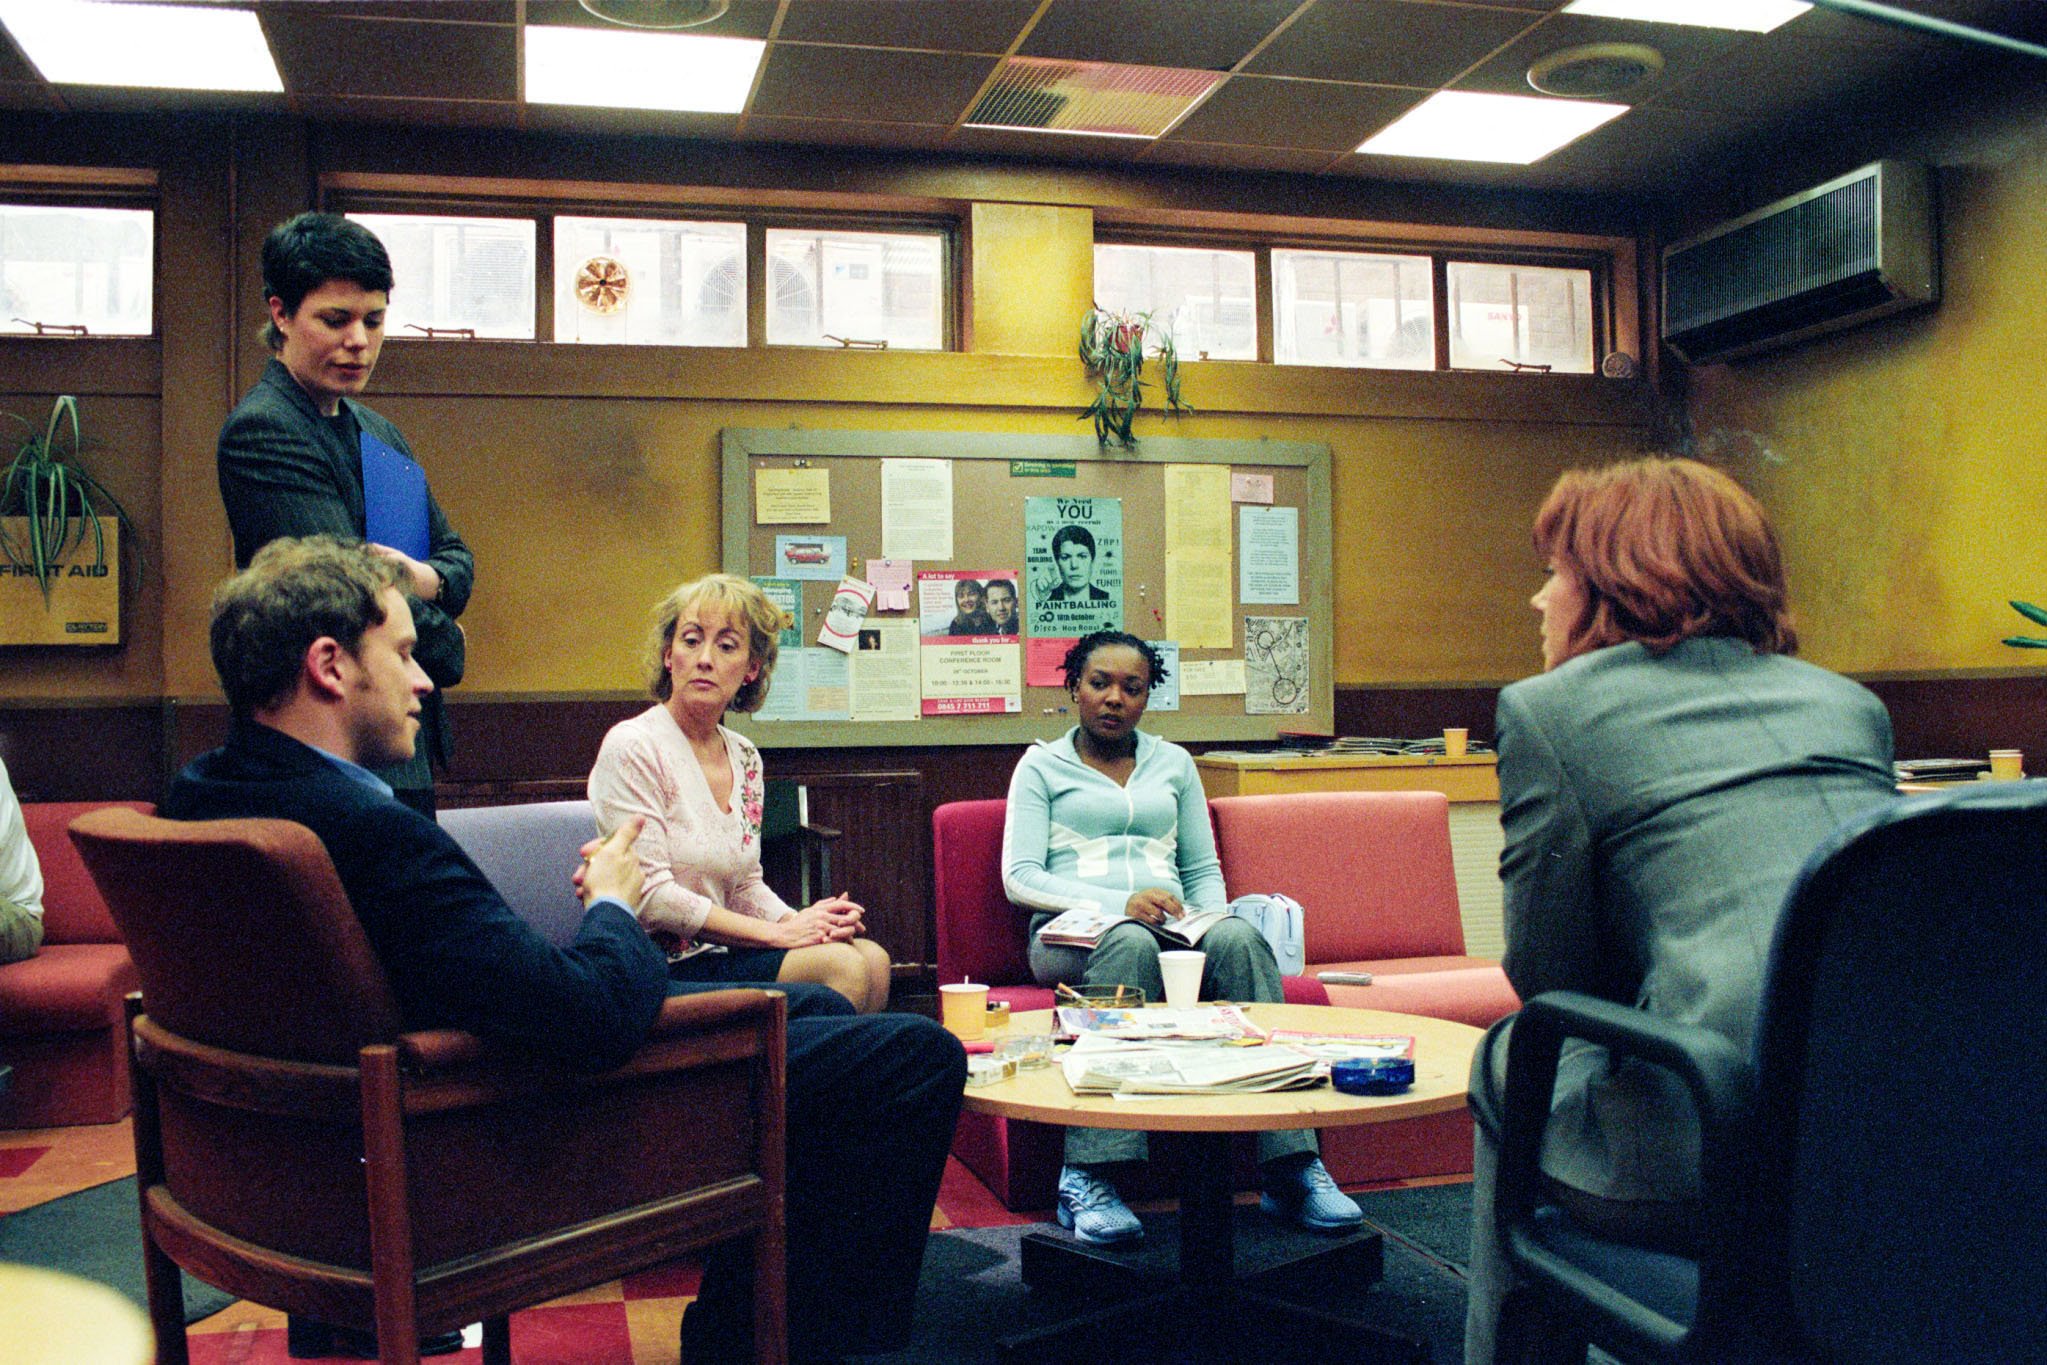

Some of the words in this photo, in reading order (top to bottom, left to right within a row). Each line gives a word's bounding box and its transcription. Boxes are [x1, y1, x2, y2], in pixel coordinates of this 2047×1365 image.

[1056, 505, 1092, 519] YOU
[1097, 538, 1119, 546] ZAP!
[0, 565, 64, 577] FIRT
[68, 565, 108, 577] AID
[1036, 600, 1117, 610] PAINTBALLING
[1034, 624, 1057, 632] Disco
